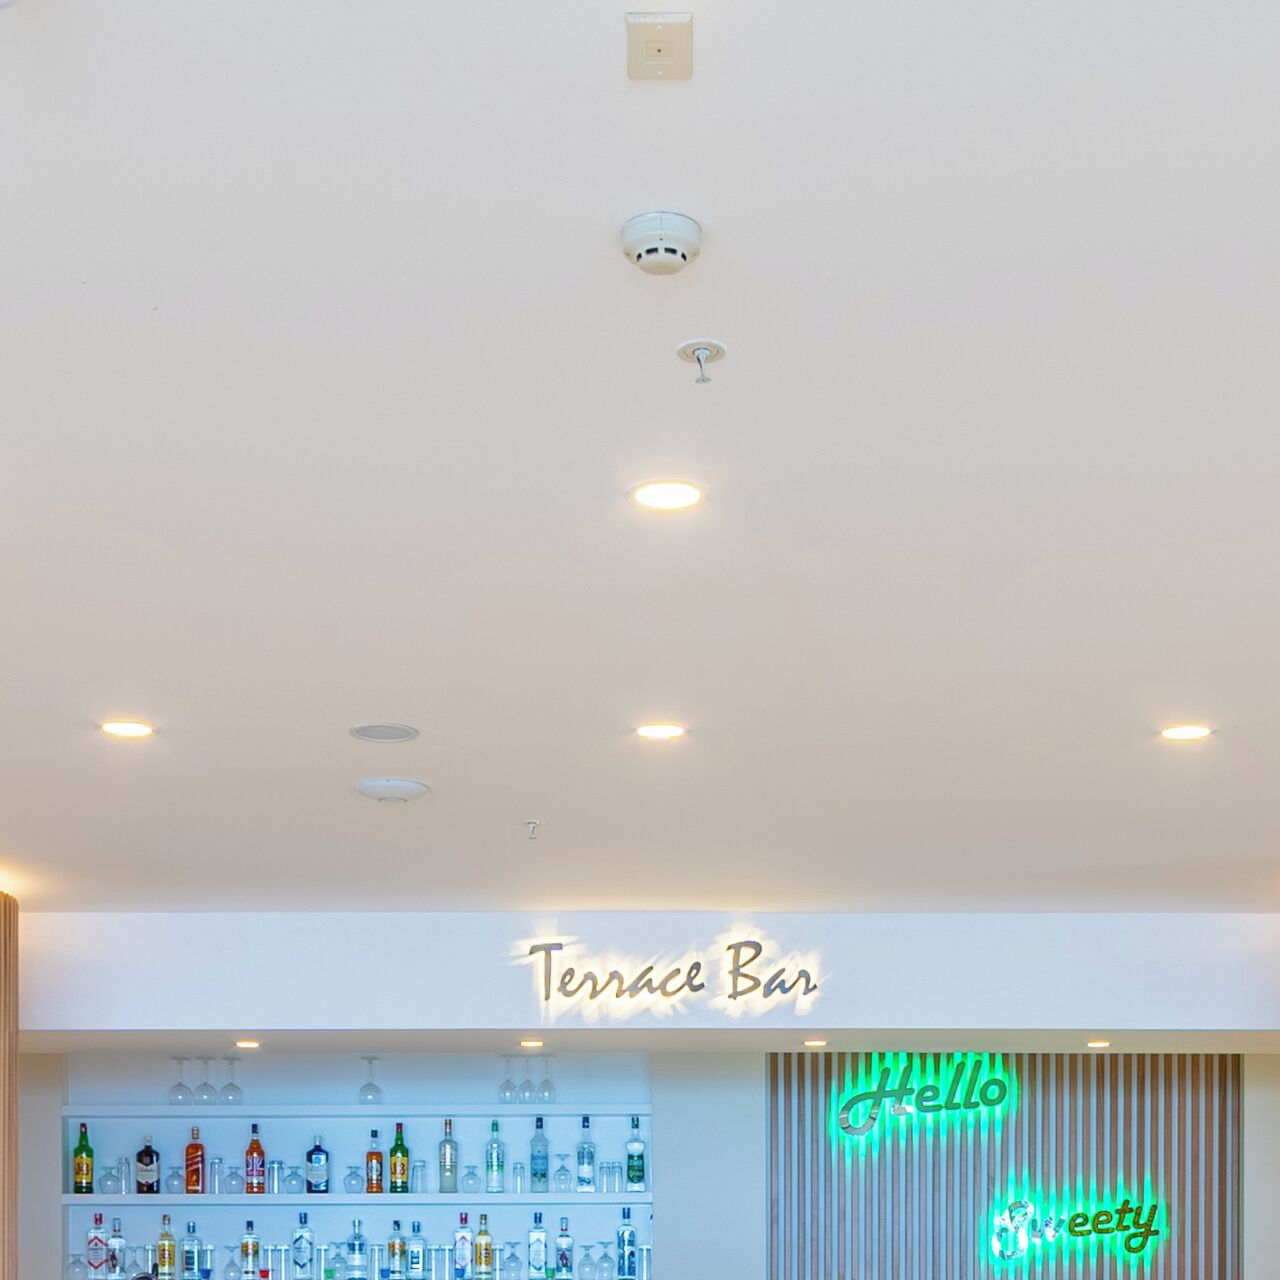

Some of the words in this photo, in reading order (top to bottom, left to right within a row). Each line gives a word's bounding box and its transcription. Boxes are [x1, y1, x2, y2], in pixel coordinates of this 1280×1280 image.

[529, 942, 705, 1001] Terrace
[727, 940, 818, 1001] Bar
[838, 1059, 1007, 1136] Hello
[991, 1199, 1160, 1261] Sweety
